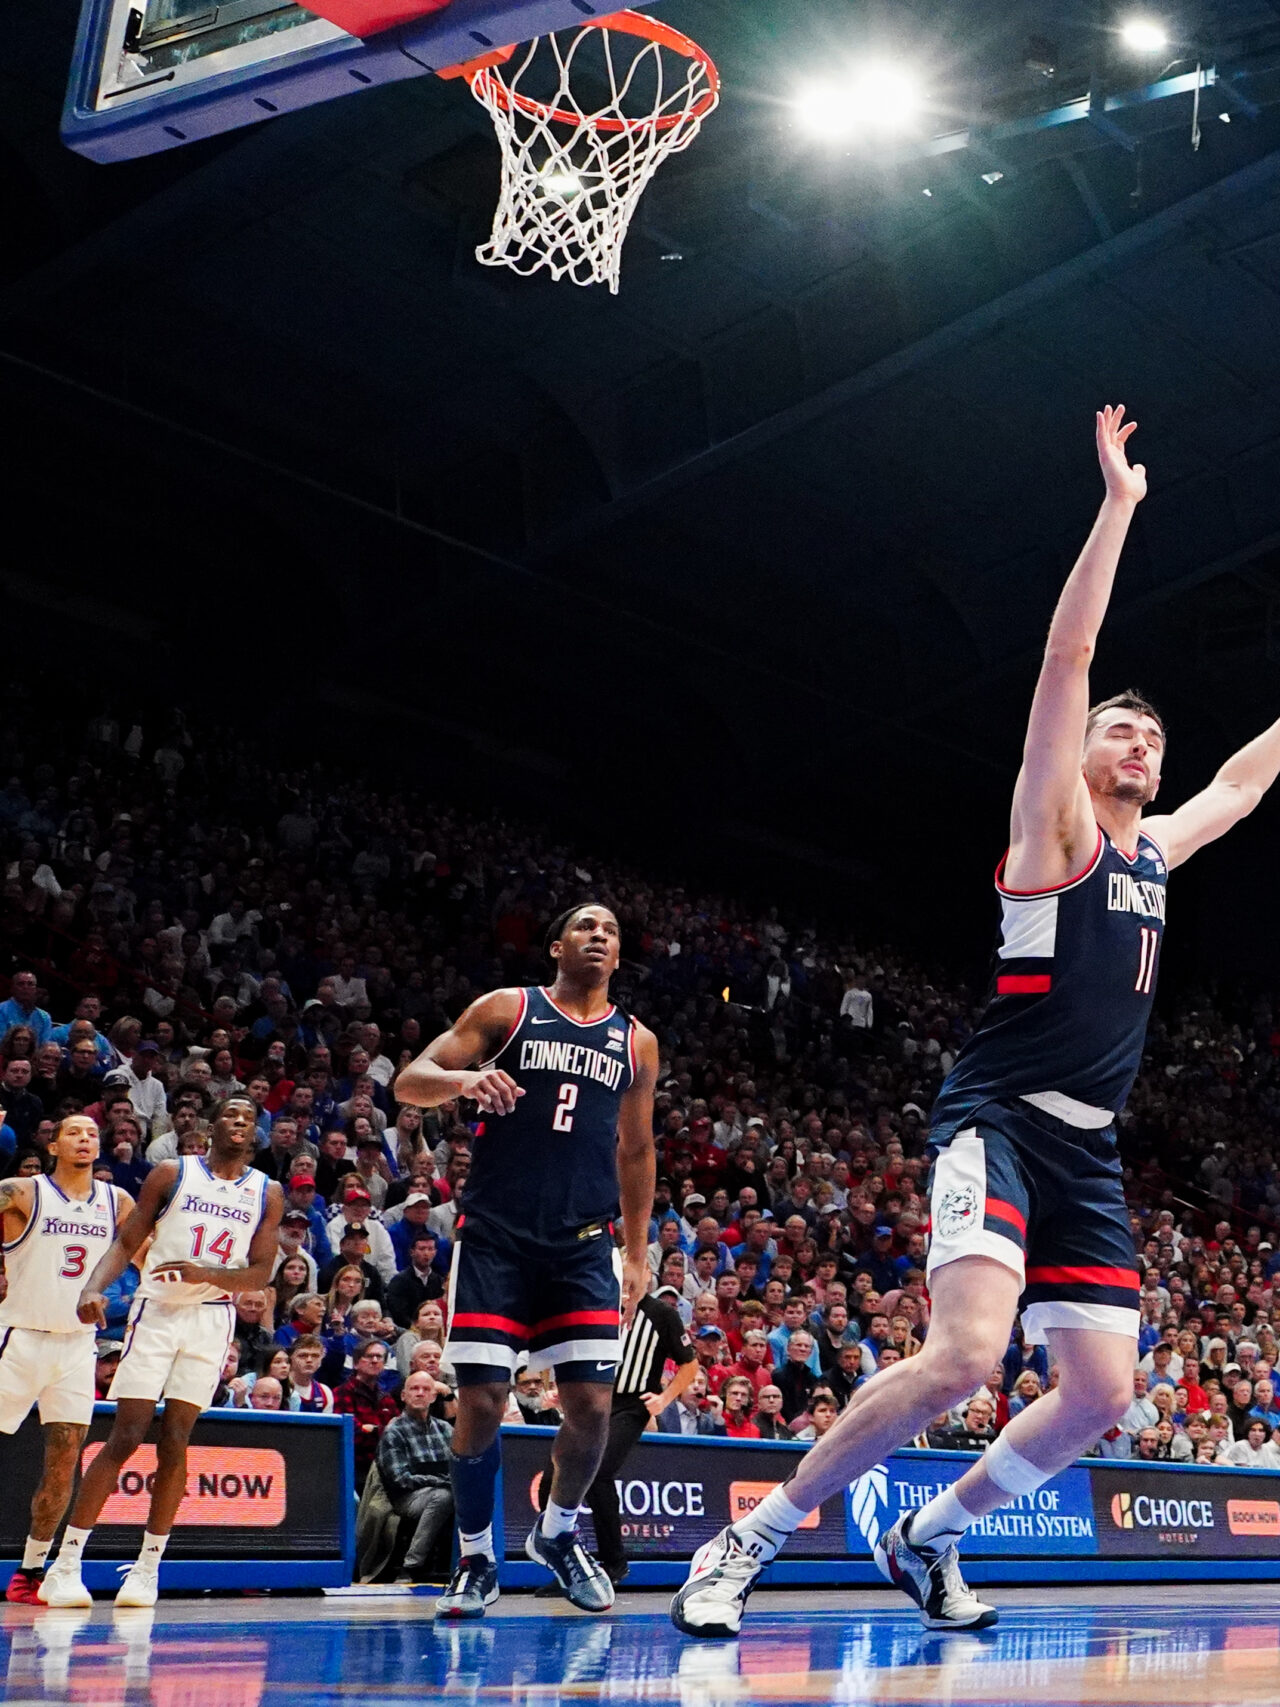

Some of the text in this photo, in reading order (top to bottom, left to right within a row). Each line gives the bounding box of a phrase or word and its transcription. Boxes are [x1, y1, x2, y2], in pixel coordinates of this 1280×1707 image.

[1134, 927, 1158, 994] 11
[519, 1039, 626, 1091] CONNECTICUT
[552, 1083, 579, 1133] 2
[180, 1194, 252, 1224] Kansas
[41, 1218, 108, 1238] Kansas
[189, 1223, 237, 1266] 14
[59, 1244, 88, 1279] 3
[198, 1473, 274, 1499] NOW
[894, 1481, 935, 1508] THE
[1038, 1490, 1060, 1511] OF
[1133, 1495, 1215, 1528] CHOICE
[620, 1523, 671, 1537] OTELS
[970, 1512, 1095, 1538] HEALTH SYSTEM
[1232, 1511, 1279, 1524] BOOK NOW
